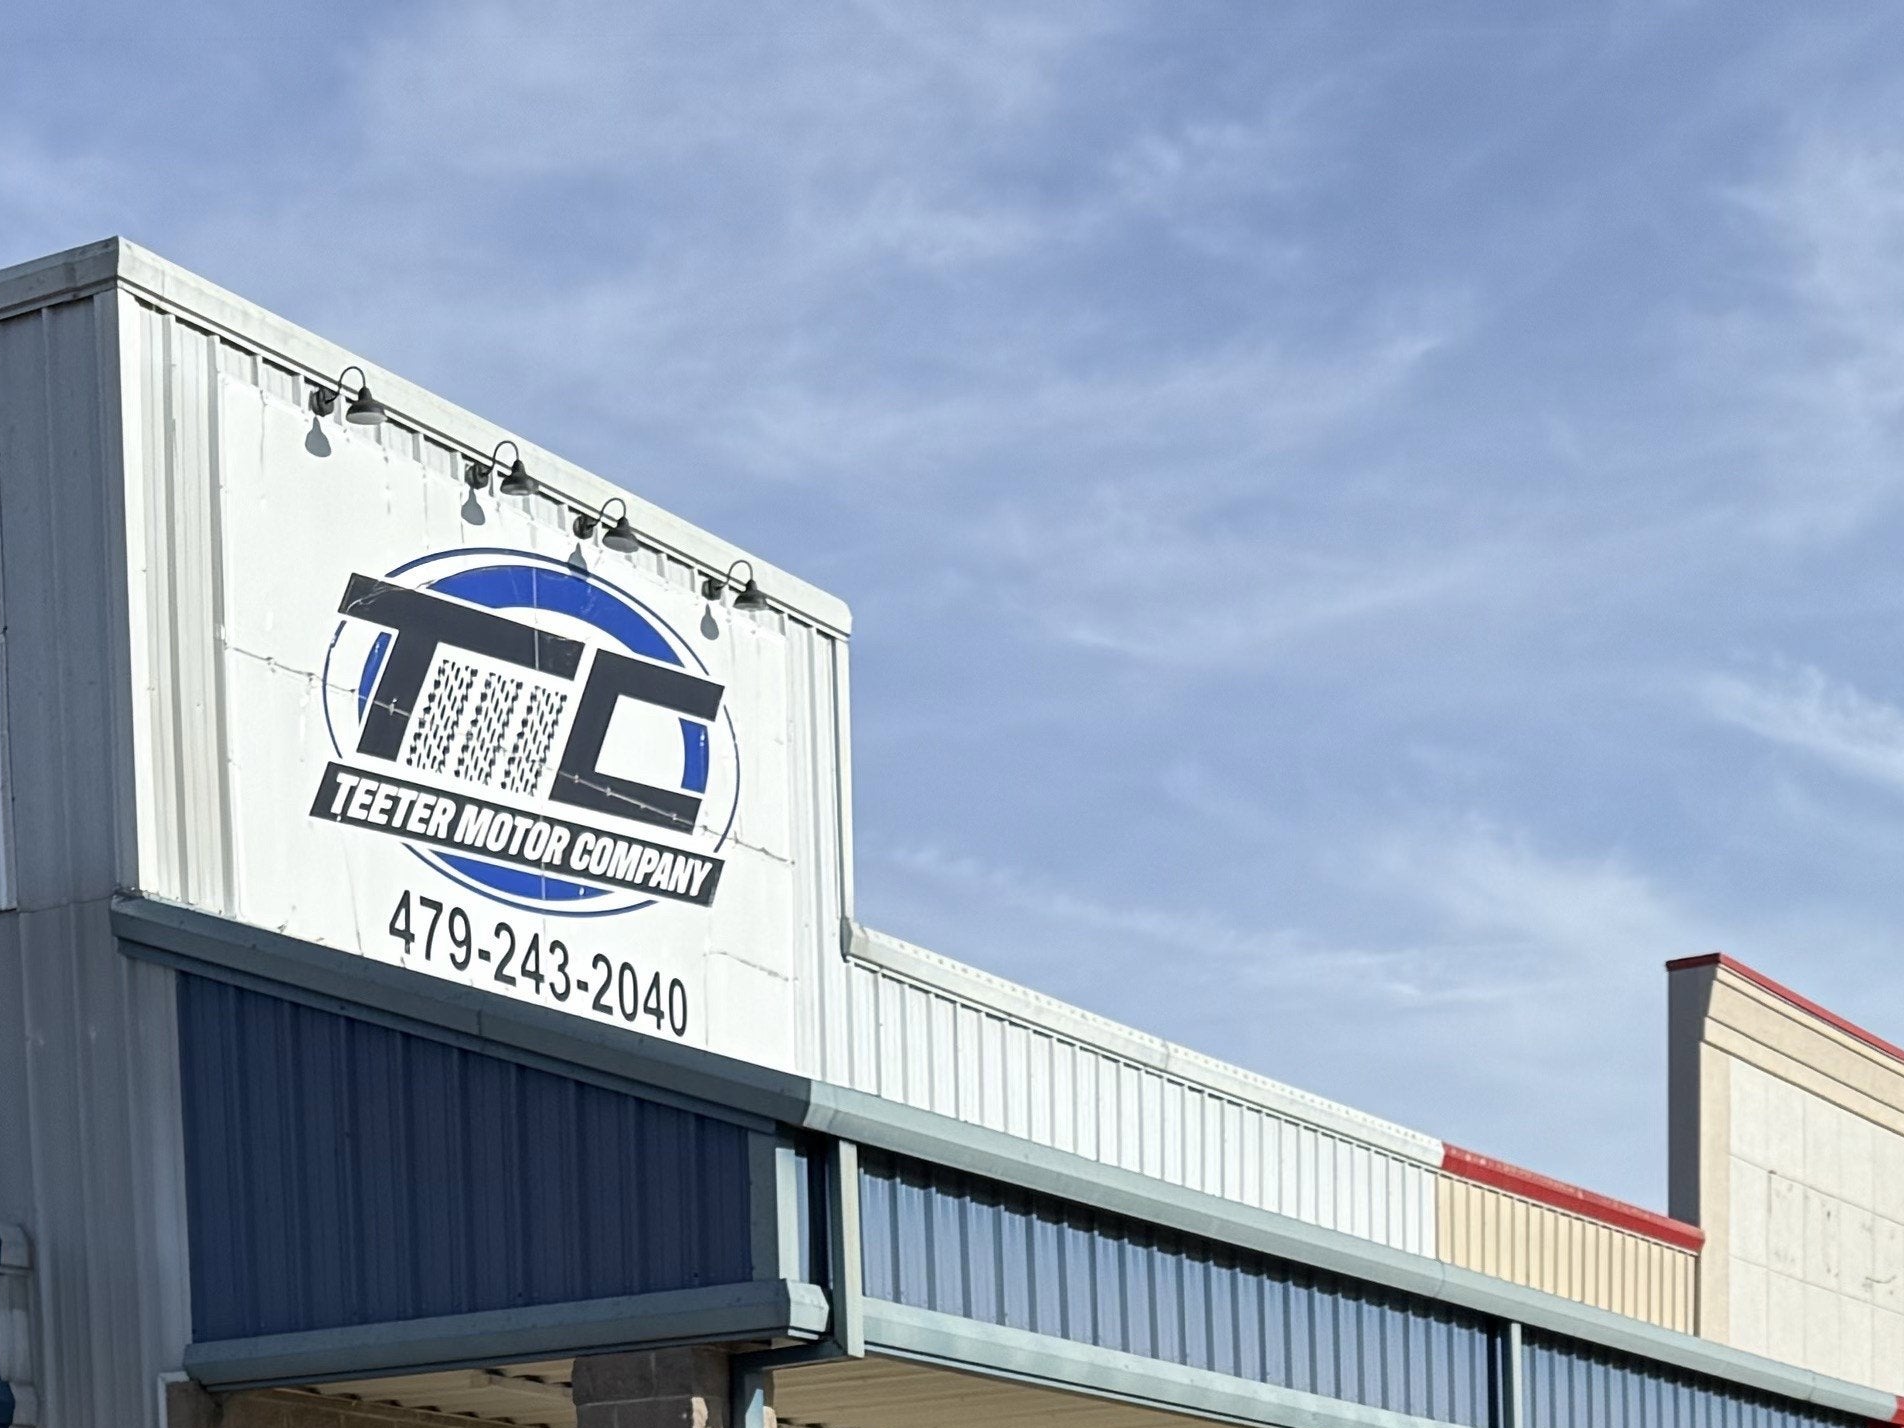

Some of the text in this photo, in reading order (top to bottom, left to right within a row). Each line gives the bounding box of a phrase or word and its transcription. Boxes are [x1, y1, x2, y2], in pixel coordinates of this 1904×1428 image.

[331, 774, 712, 897] TEETER MOTOR COMPANY
[388, 889, 688, 1037] 479-243-2040
